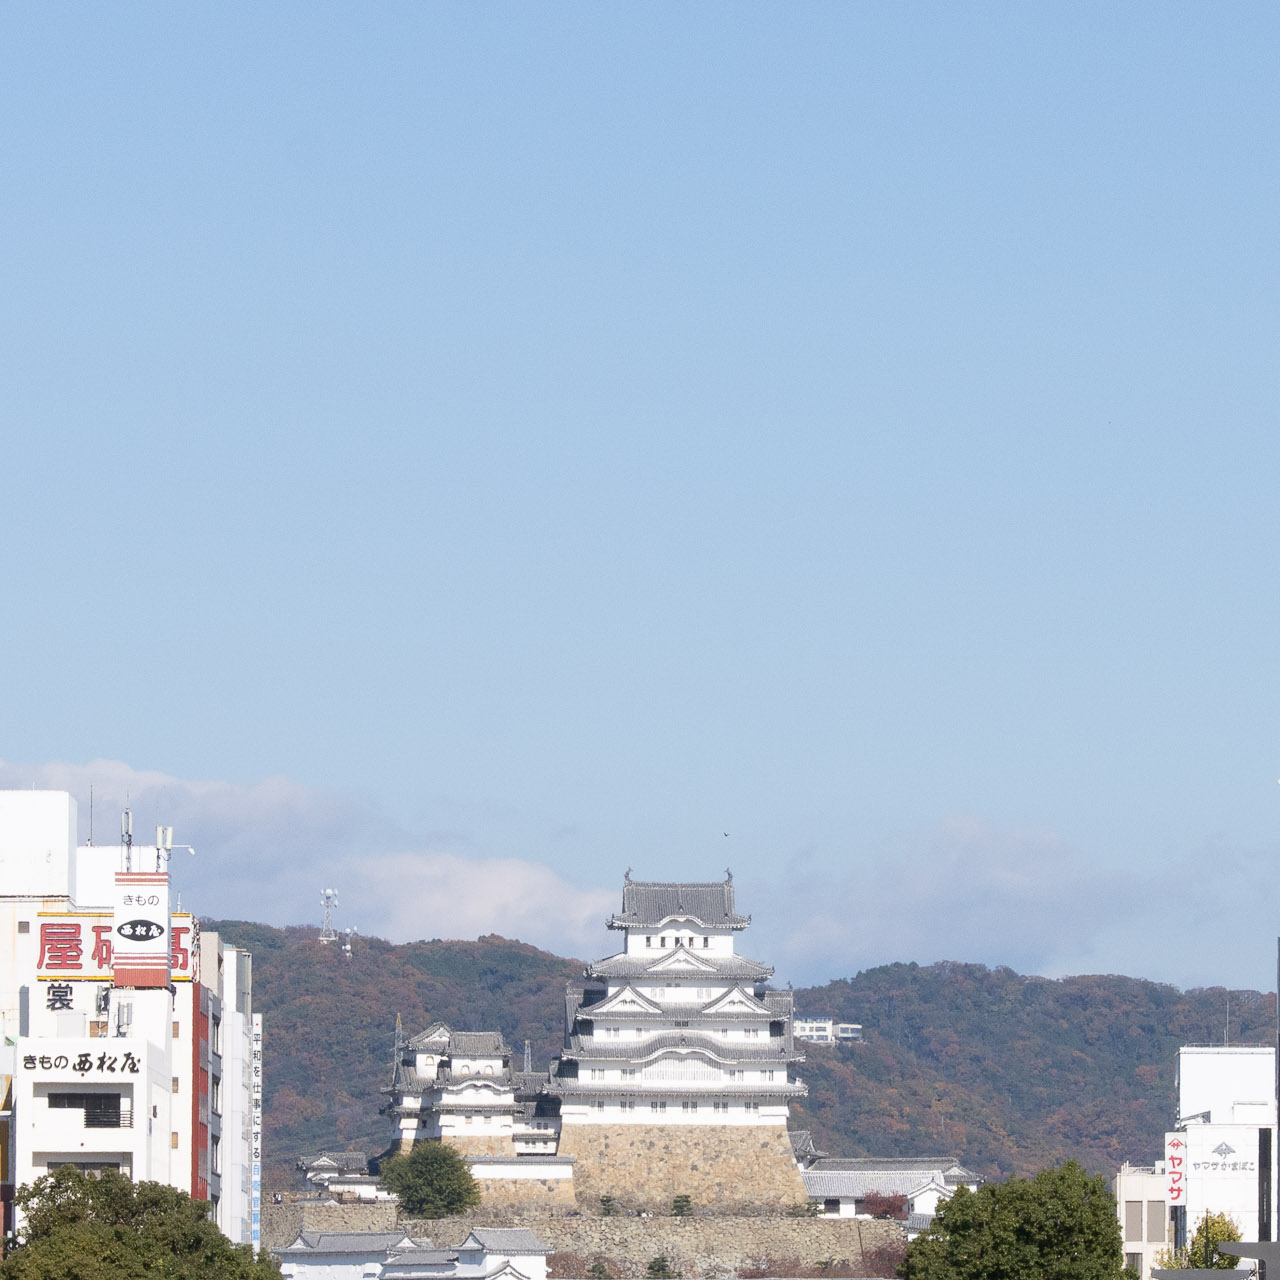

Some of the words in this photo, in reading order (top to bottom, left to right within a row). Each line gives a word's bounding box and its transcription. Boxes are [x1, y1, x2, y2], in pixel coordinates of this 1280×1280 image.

[122, 893, 161, 906] きもの
[120, 922, 164, 938] 西松屋
[23, 1054, 68, 1070] きもの
[72, 1051, 142, 1073] 西松屋
[1193, 1161, 1256, 1172] ヤマサかまぼこ
[1168, 1155, 1183, 1201] ヤマサ
